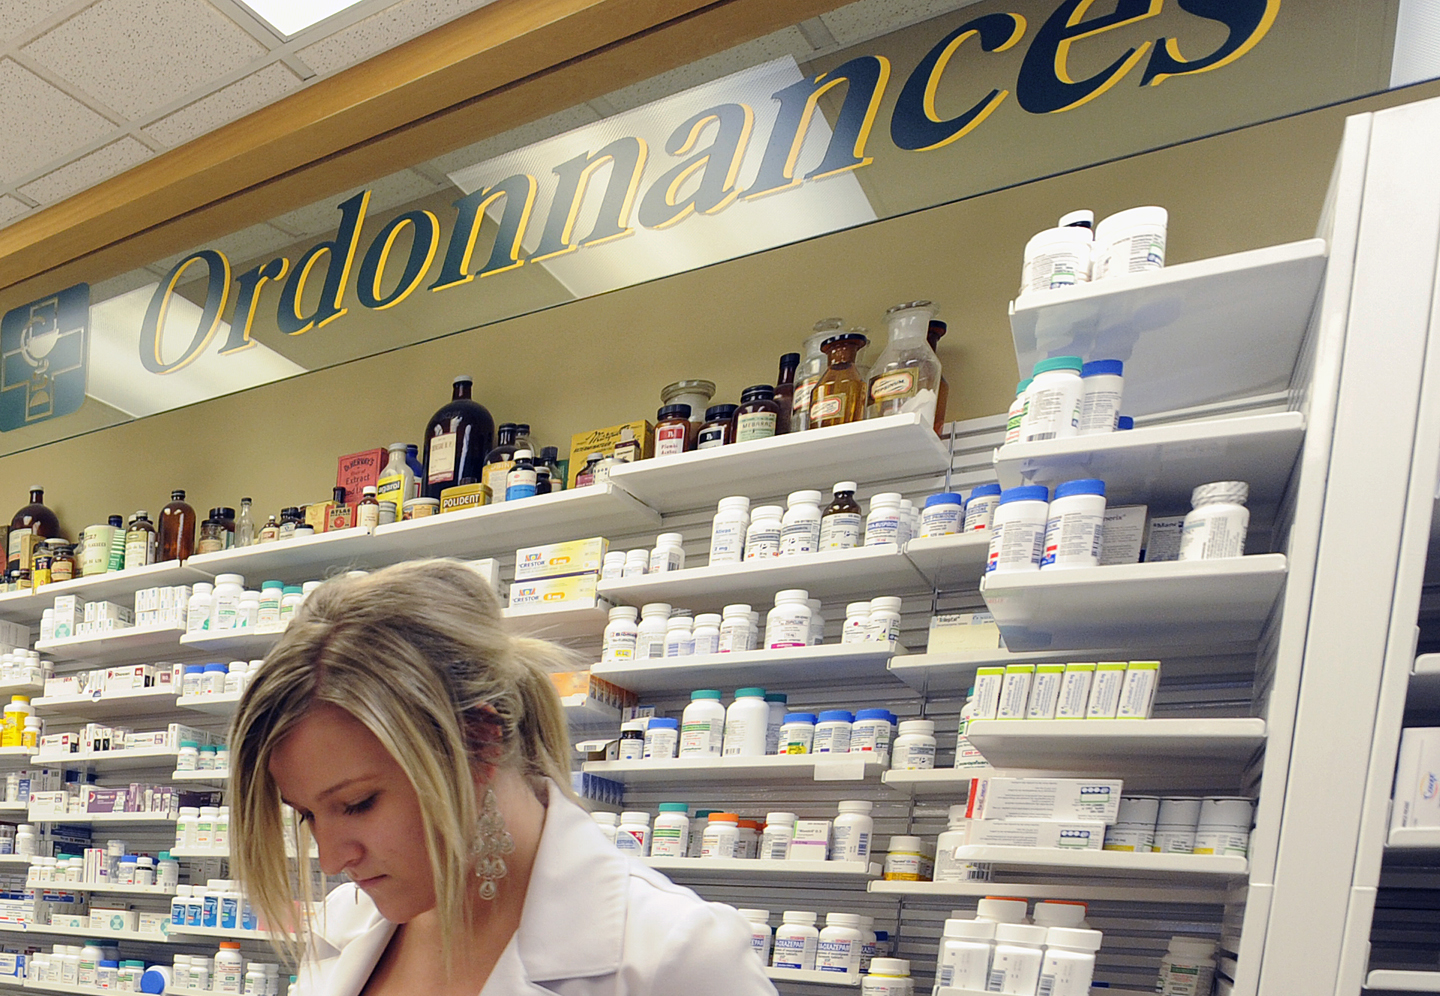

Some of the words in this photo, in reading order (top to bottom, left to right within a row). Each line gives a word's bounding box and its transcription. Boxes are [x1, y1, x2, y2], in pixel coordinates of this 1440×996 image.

[140, 0, 1280, 375] Ordonnances
[346, 474, 370, 485] Extract
[443, 493, 480, 508] POLIDENT
[519, 560, 545, 569] CRESTOR
[513, 595, 540, 603] CRESTOR
